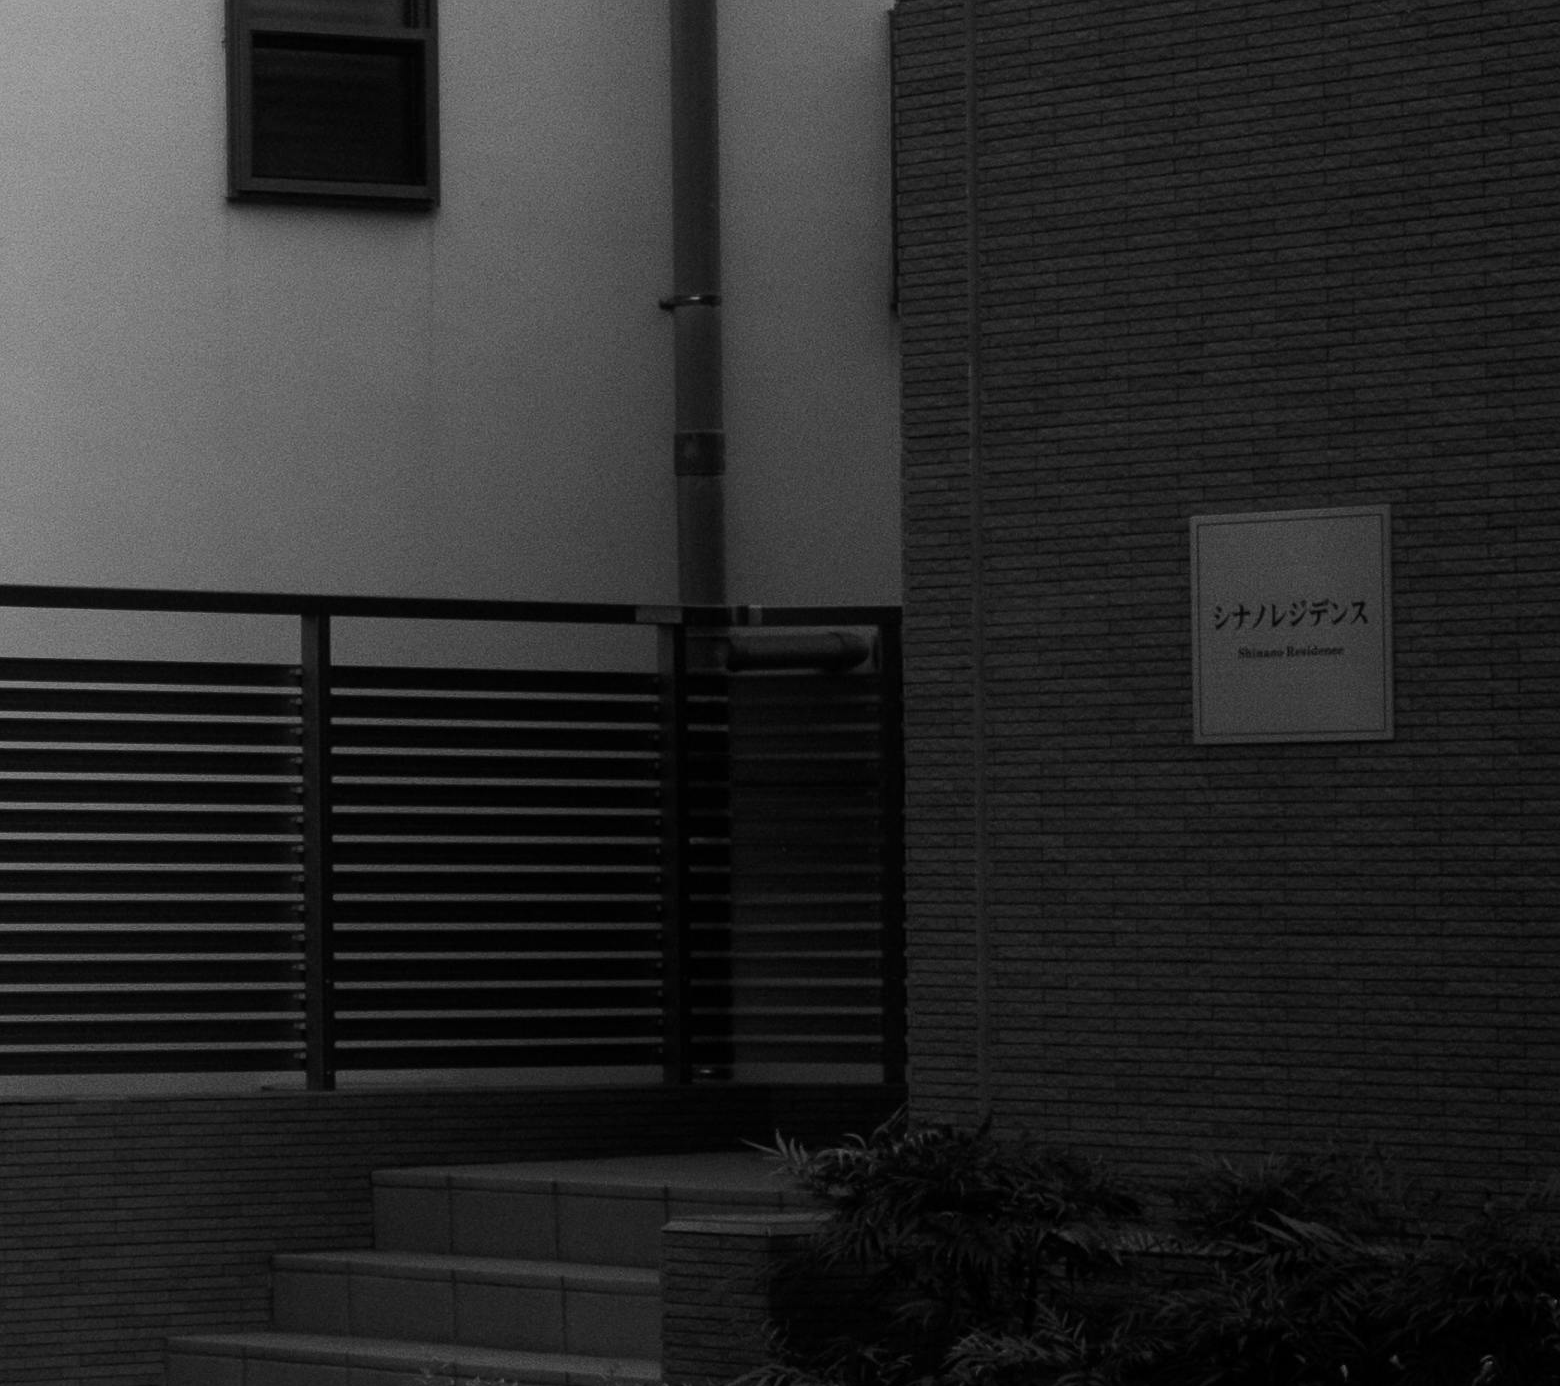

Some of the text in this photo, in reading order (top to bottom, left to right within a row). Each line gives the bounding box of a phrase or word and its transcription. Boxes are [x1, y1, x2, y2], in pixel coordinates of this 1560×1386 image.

[1213, 598, 1369, 631] シナノレジデンス
